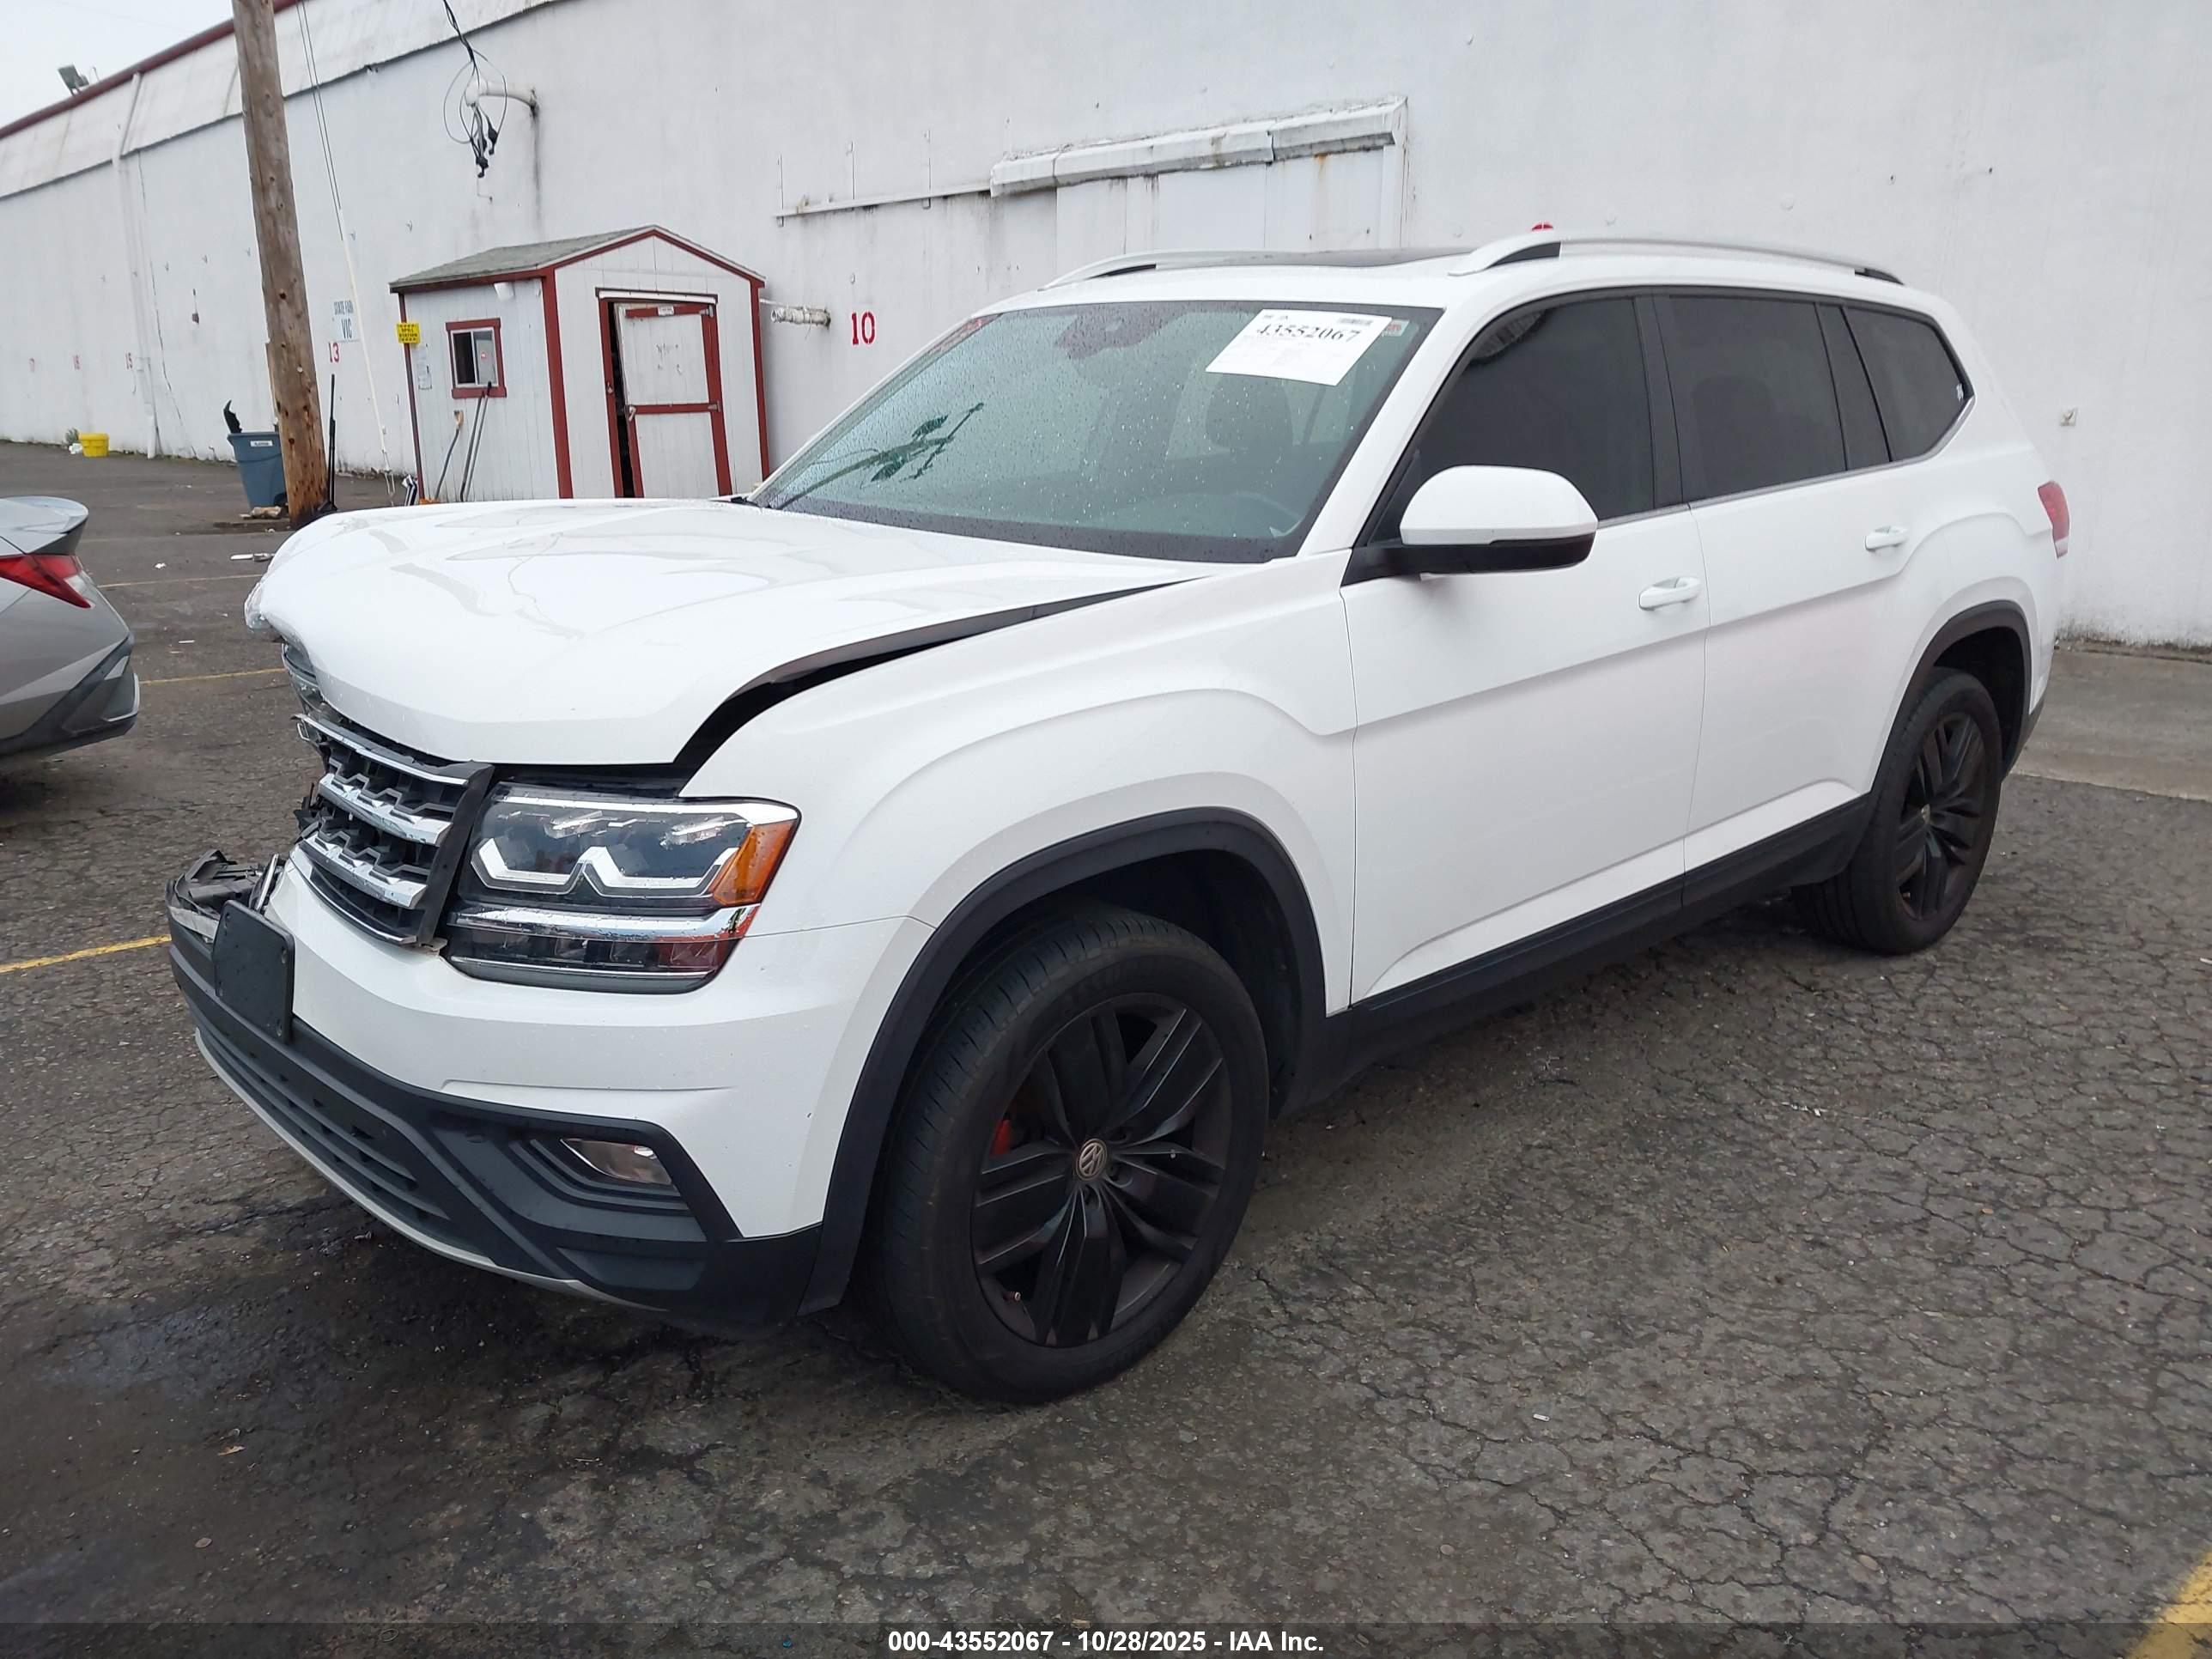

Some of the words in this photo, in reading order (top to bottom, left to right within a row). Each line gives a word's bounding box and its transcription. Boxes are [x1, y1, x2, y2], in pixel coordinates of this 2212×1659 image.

[341, 318, 352, 339] VIC
[852, 311, 875, 344] 10
[328, 342, 339, 362] 13
